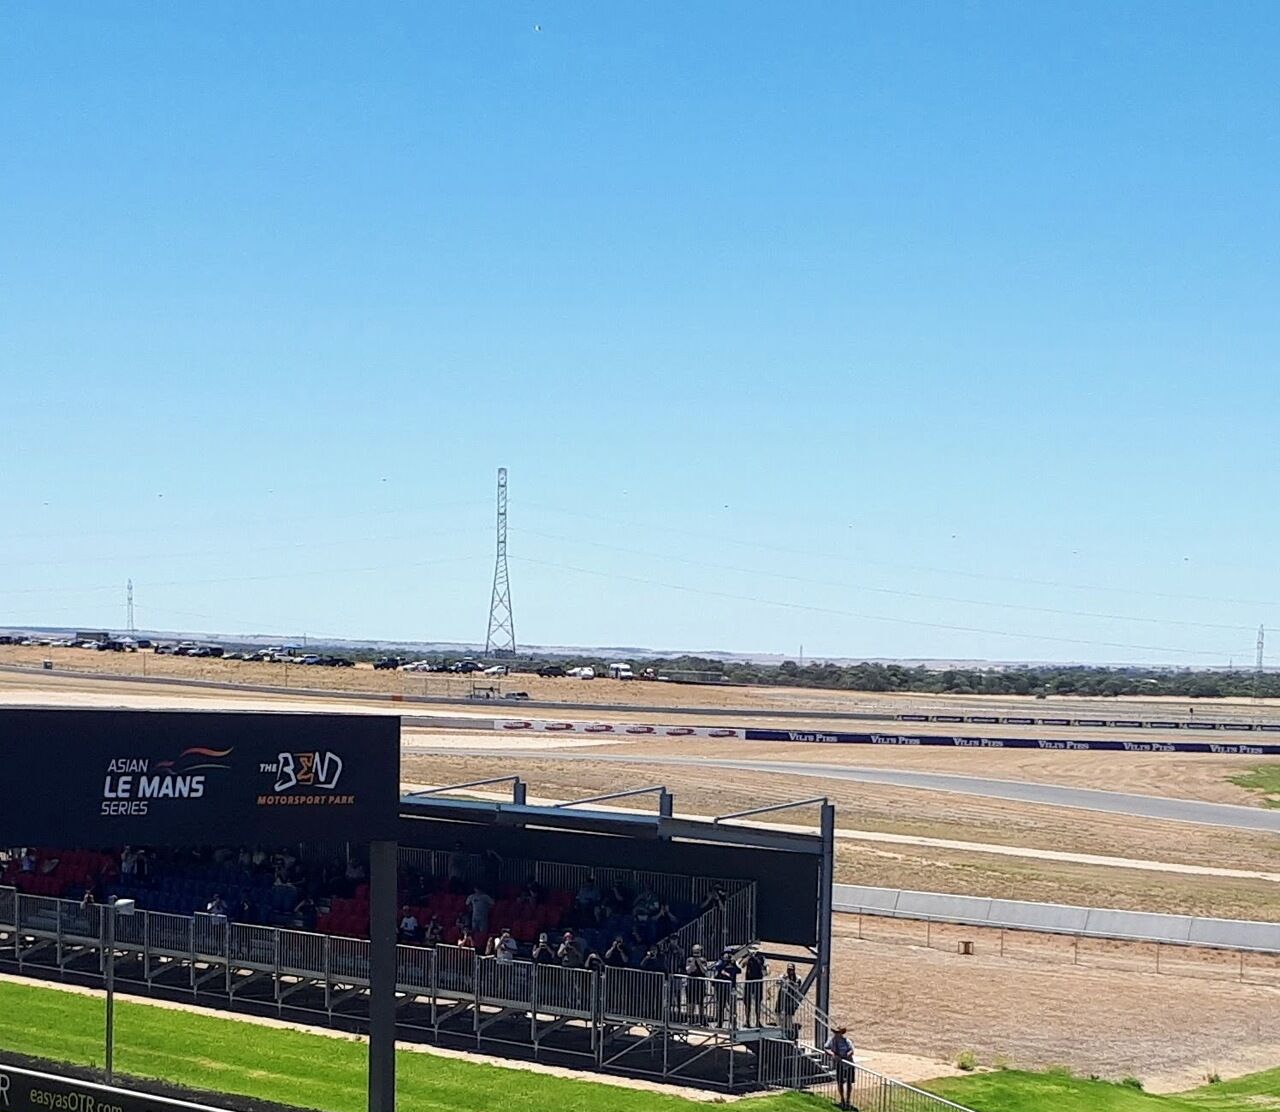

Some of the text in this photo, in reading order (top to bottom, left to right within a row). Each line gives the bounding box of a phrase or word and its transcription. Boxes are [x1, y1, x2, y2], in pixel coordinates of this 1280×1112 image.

[108, 759, 148, 773] ASIAN
[260, 752, 342, 792] THE BEND
[104, 776, 205, 798] LE MANS
[257, 796, 354, 806] MOTORSPORT PARK
[101, 802, 148, 815] SERIES
